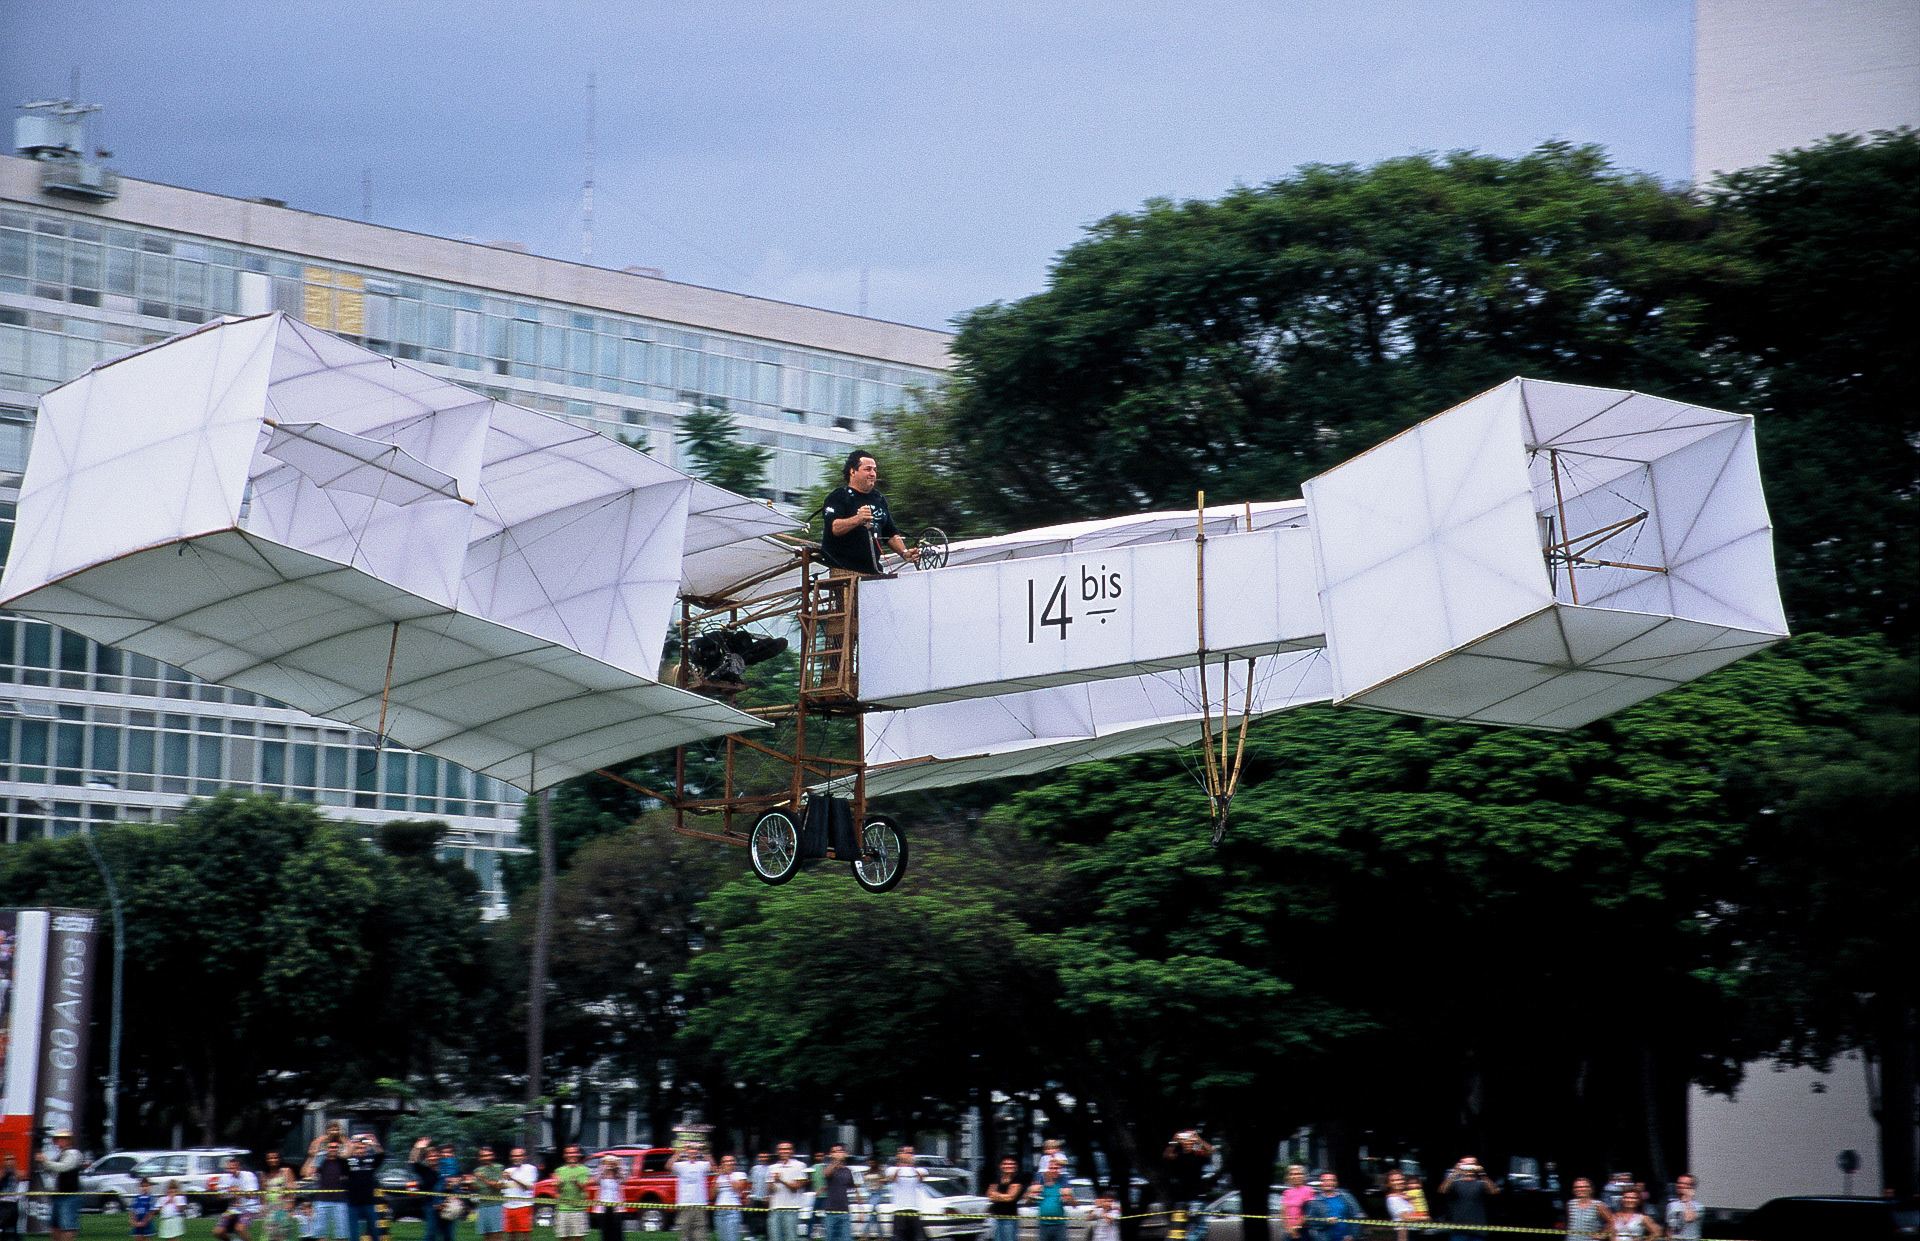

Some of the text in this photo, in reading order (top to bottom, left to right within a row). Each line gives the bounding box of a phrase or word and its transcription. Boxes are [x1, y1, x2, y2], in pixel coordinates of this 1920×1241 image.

[1028, 564, 1122, 643] 14 bis
[53, 938, 87, 1025] Anos
